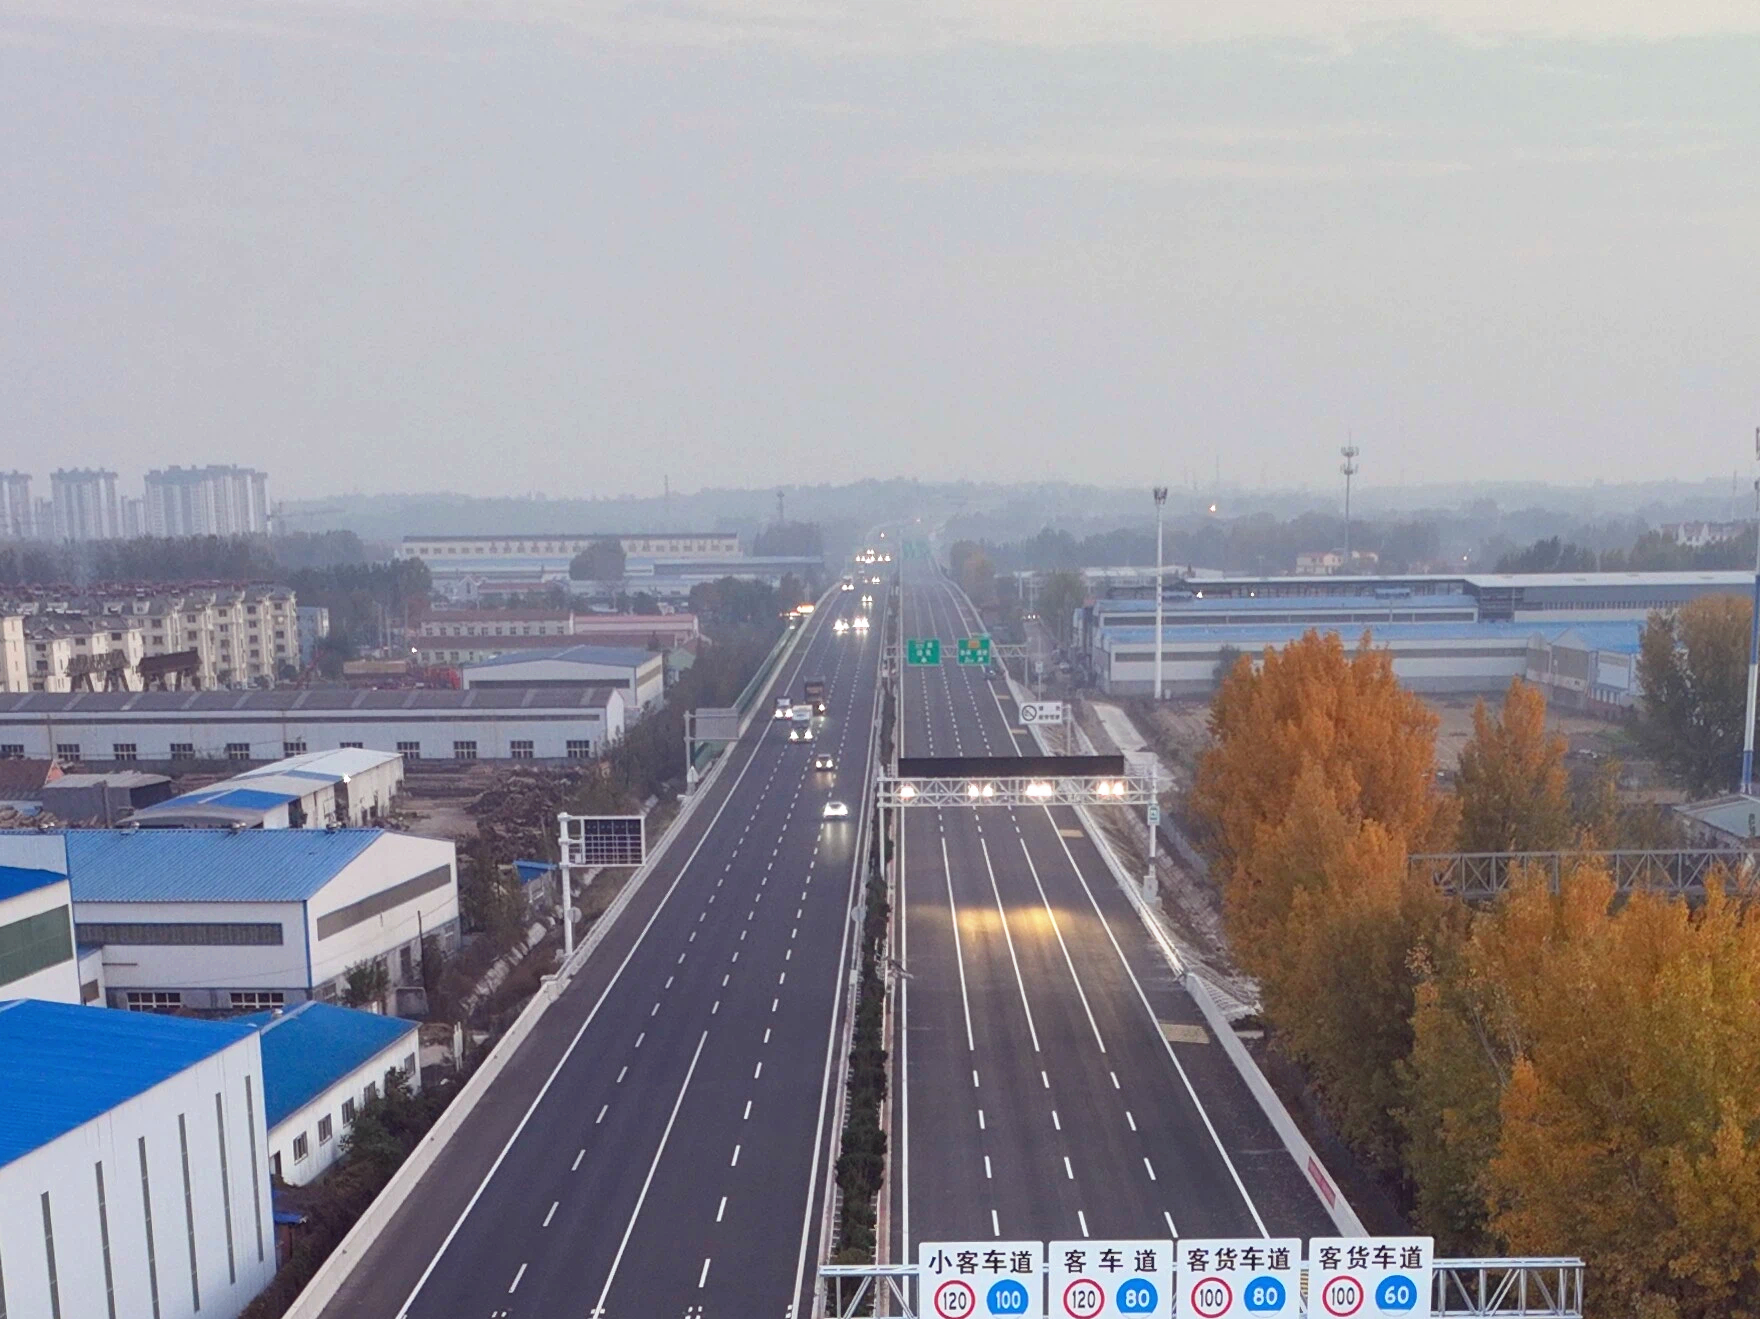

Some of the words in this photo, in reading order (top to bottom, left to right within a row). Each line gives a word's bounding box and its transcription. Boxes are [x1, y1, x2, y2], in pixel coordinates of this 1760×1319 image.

[928, 1249, 1033, 1274] 小客车道
[1064, 1248, 1158, 1274] 客车道
[1187, 1246, 1291, 1272] 客货车道
[1319, 1245, 1423, 1270] 客货车道
[943, 1291, 967, 1310] 120
[995, 1290, 1021, 1309] 100
[1072, 1290, 1096, 1309] 120
[1125, 1289, 1150, 1308] 80
[1199, 1288, 1224, 1307] 100
[1253, 1287, 1278, 1306] 80
[1331, 1287, 1355, 1306] 100
[1384, 1286, 1410, 1304] 60
